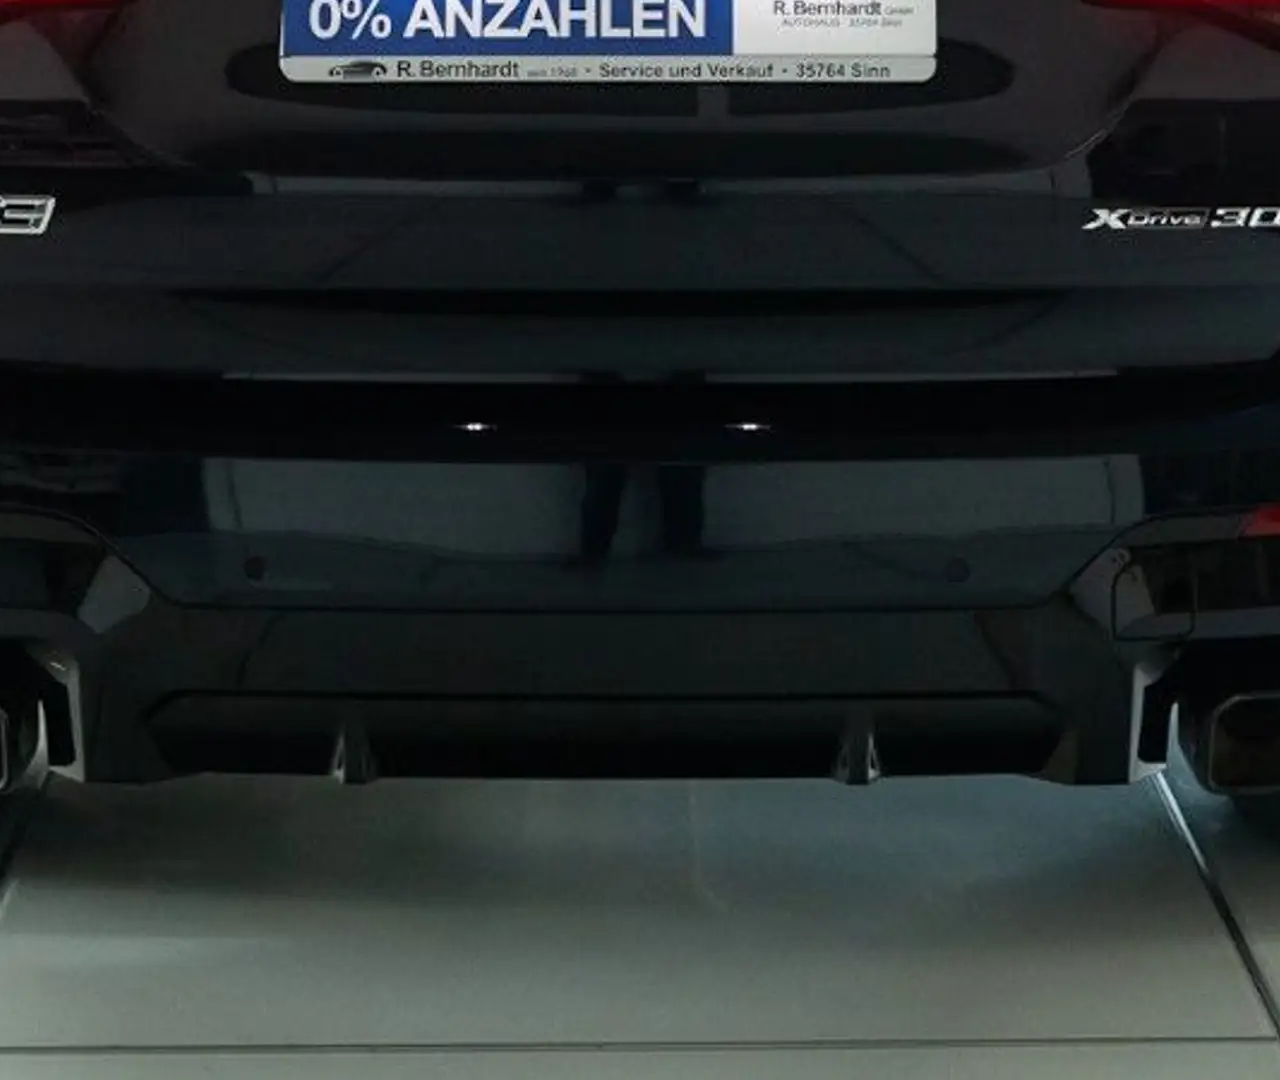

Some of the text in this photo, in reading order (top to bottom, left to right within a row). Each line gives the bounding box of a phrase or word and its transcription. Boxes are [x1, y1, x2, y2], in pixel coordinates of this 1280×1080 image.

[773, 0, 791, 16] R.
[793, 0, 883, 16] Bernhardt
[396, 60, 416, 78] R.
[420, 59, 520, 78] Bernhardt
[599, 62, 664, 78] Service
[669, 62, 702, 78] und
[706, 62, 775, 78] Verkauf
[795, 62, 847, 78] 35764
[850, 62, 892, 78] Sinn
